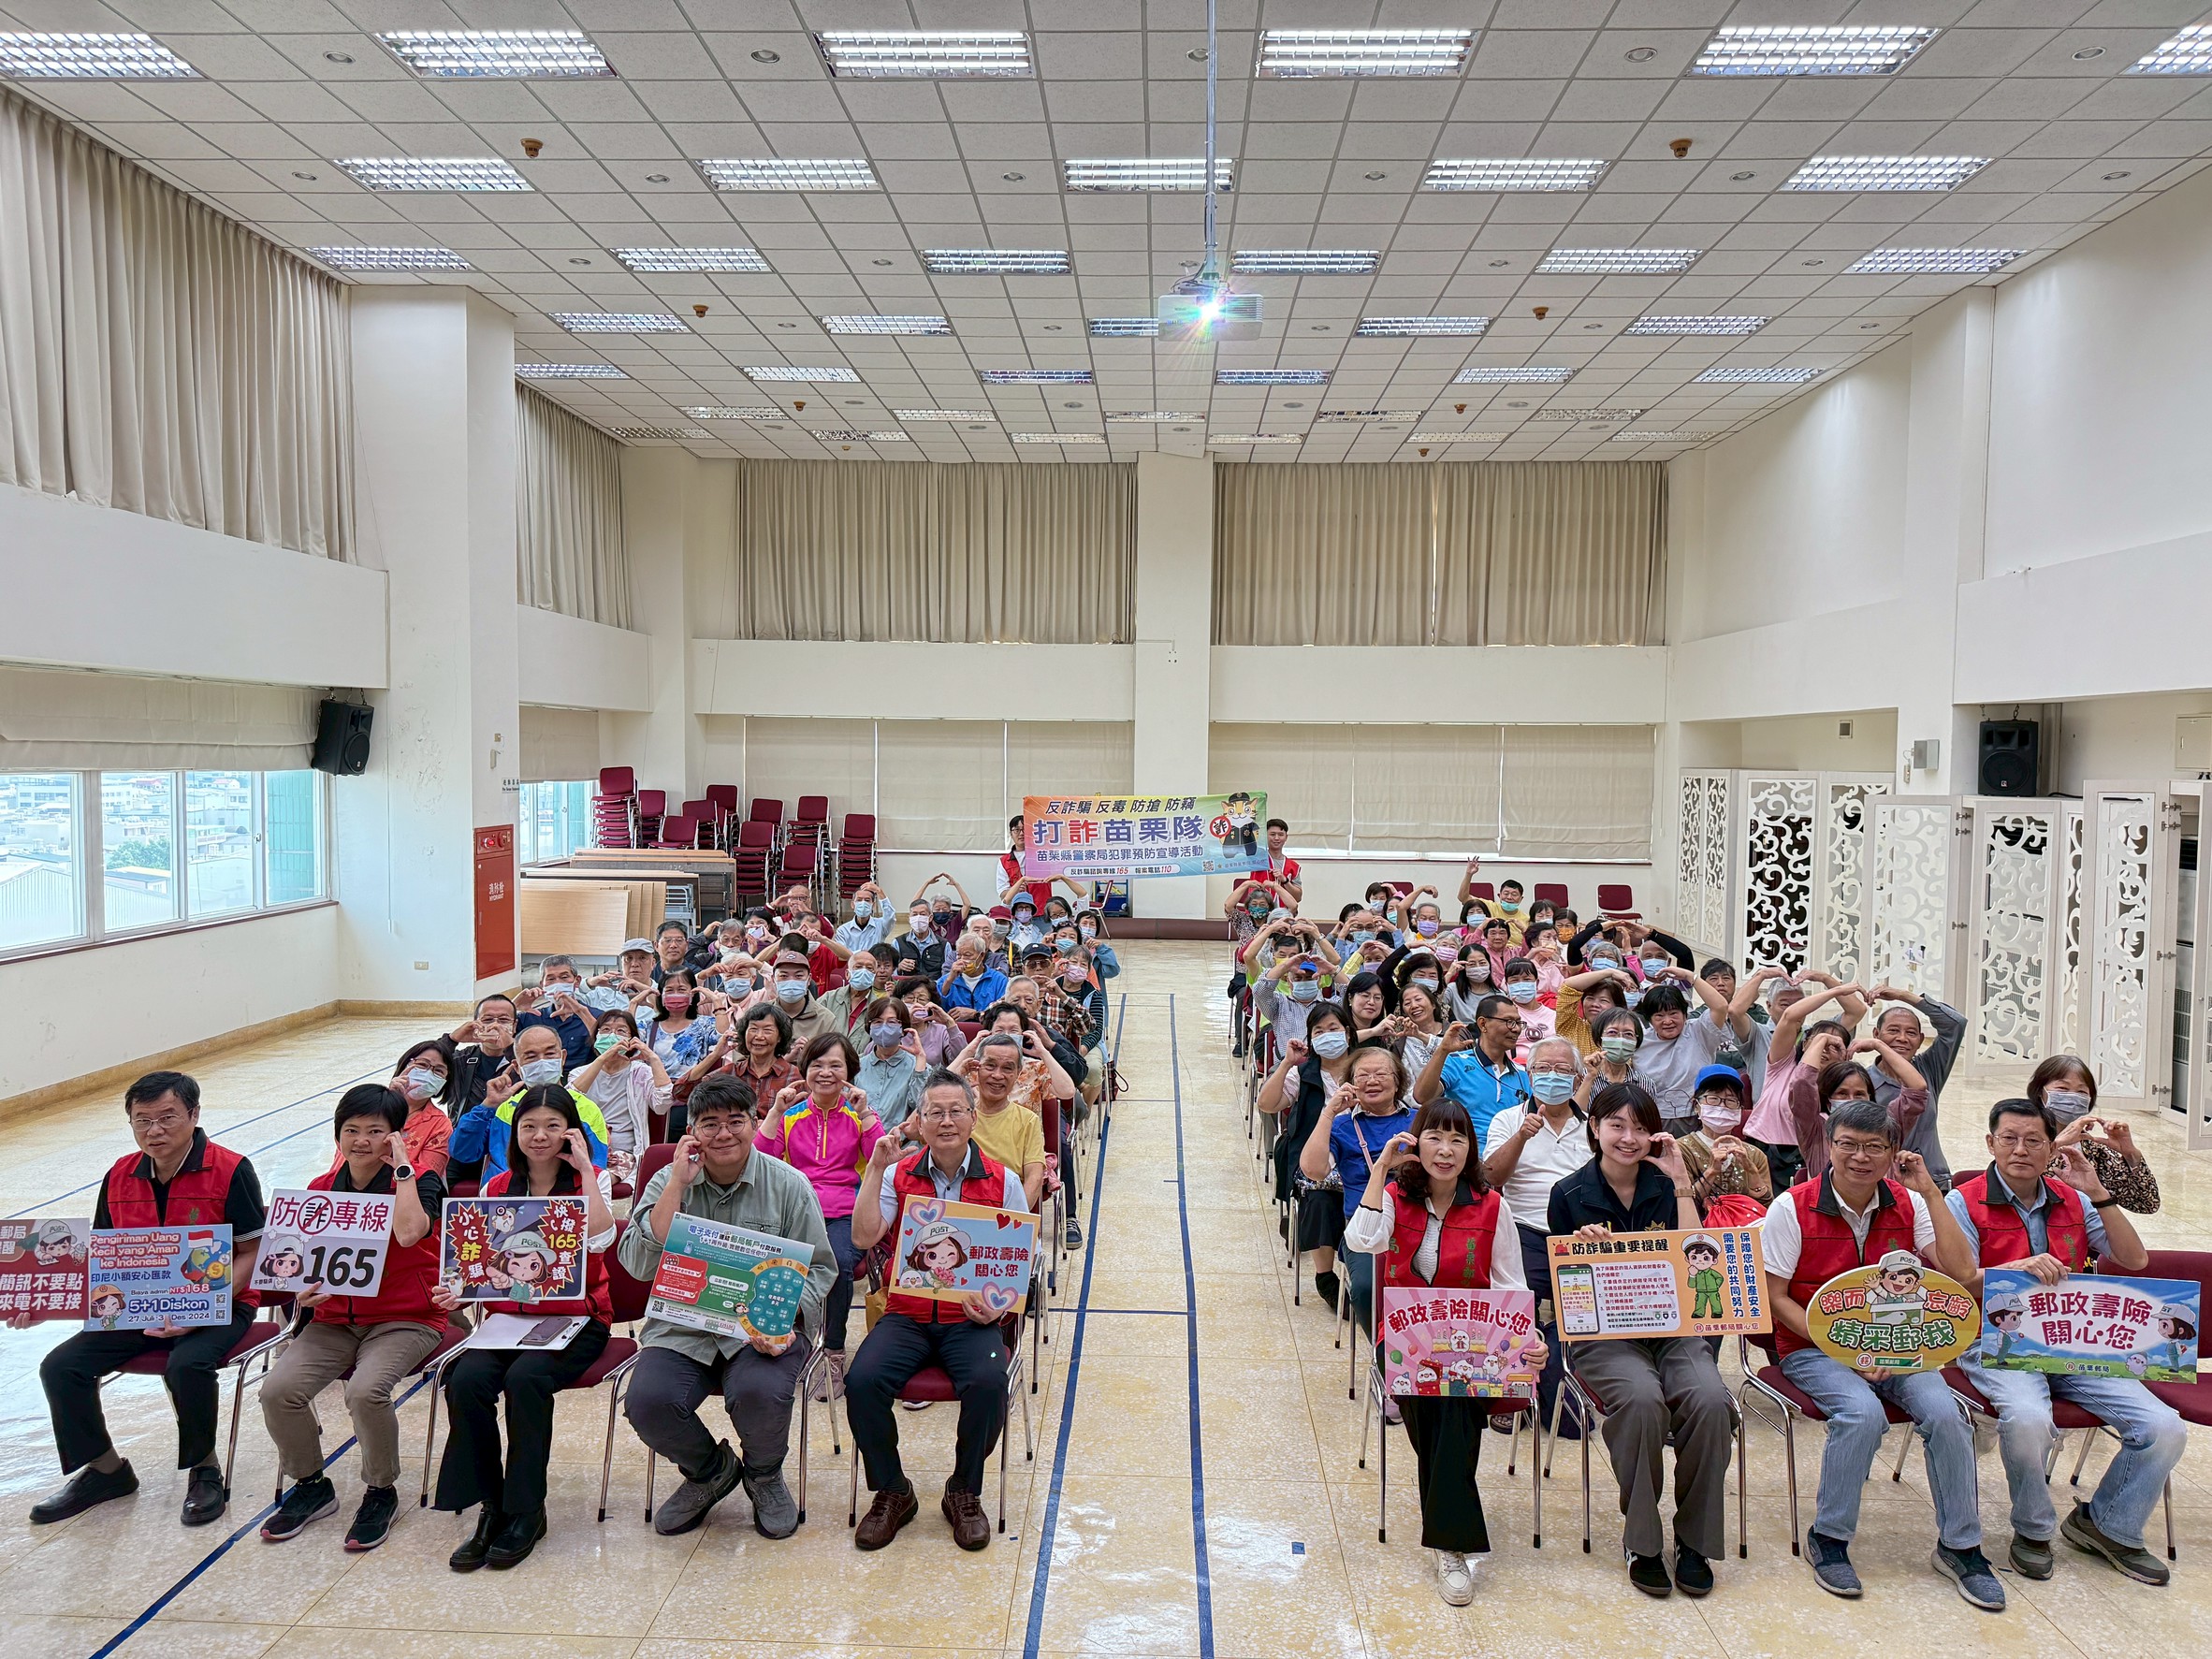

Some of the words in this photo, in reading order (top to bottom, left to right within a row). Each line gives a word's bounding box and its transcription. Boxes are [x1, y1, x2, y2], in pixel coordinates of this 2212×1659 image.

[1045, 800, 1092, 814] 反詐騙
[1096, 799, 1127, 814] 反毒
[1129, 798, 1161, 813] 防搶
[1164, 796, 1197, 811] 防竊
[1033, 814, 1204, 844] 打詐苗栗隊
[1037, 845, 1203, 862] 苗栗縣警察局犯罪預防宣導活動
[90, 1234, 149, 1245] Pengiriman
[152, 1232, 180, 1244] Uang
[930, 1226, 950, 1236] POST
[90, 1246, 116, 1256] Kecil
[118, 1246, 145, 1257] yang
[147, 1244, 179, 1255] Aman
[458, 1212, 485, 1278] 小心詐騙
[968, 1245, 1029, 1262] 郵政壽險
[1571, 1238, 1669, 1256] 防詐騙重要提醒
[100, 1259, 113, 1268] ke
[116, 1257, 168, 1267] Indonesia
[302, 1245, 378, 1288] 165
[1899, 1256, 1916, 1264] POST
[91, 1270, 171, 1283] 印尼小額安心匯款
[975, 1263, 1019, 1277] 關心您
[1723, 1232, 1744, 1317] 需要您的共同努力
[1740, 1231, 1761, 1317] 保障您的財產安全
[0, 1273, 84, 1291] 簡訊不要點
[0, 1291, 83, 1311] 來電不要接
[1820, 1288, 1866, 1314] 樂而
[1924, 1289, 1973, 1319] 忘齡
[2028, 1290, 2153, 1327] 郵政壽險
[1387, 1298, 1533, 1336] 郵政壽險關心您
[1828, 1318, 1957, 1352] 精采郵我
[2041, 1319, 2138, 1350] 關心您
